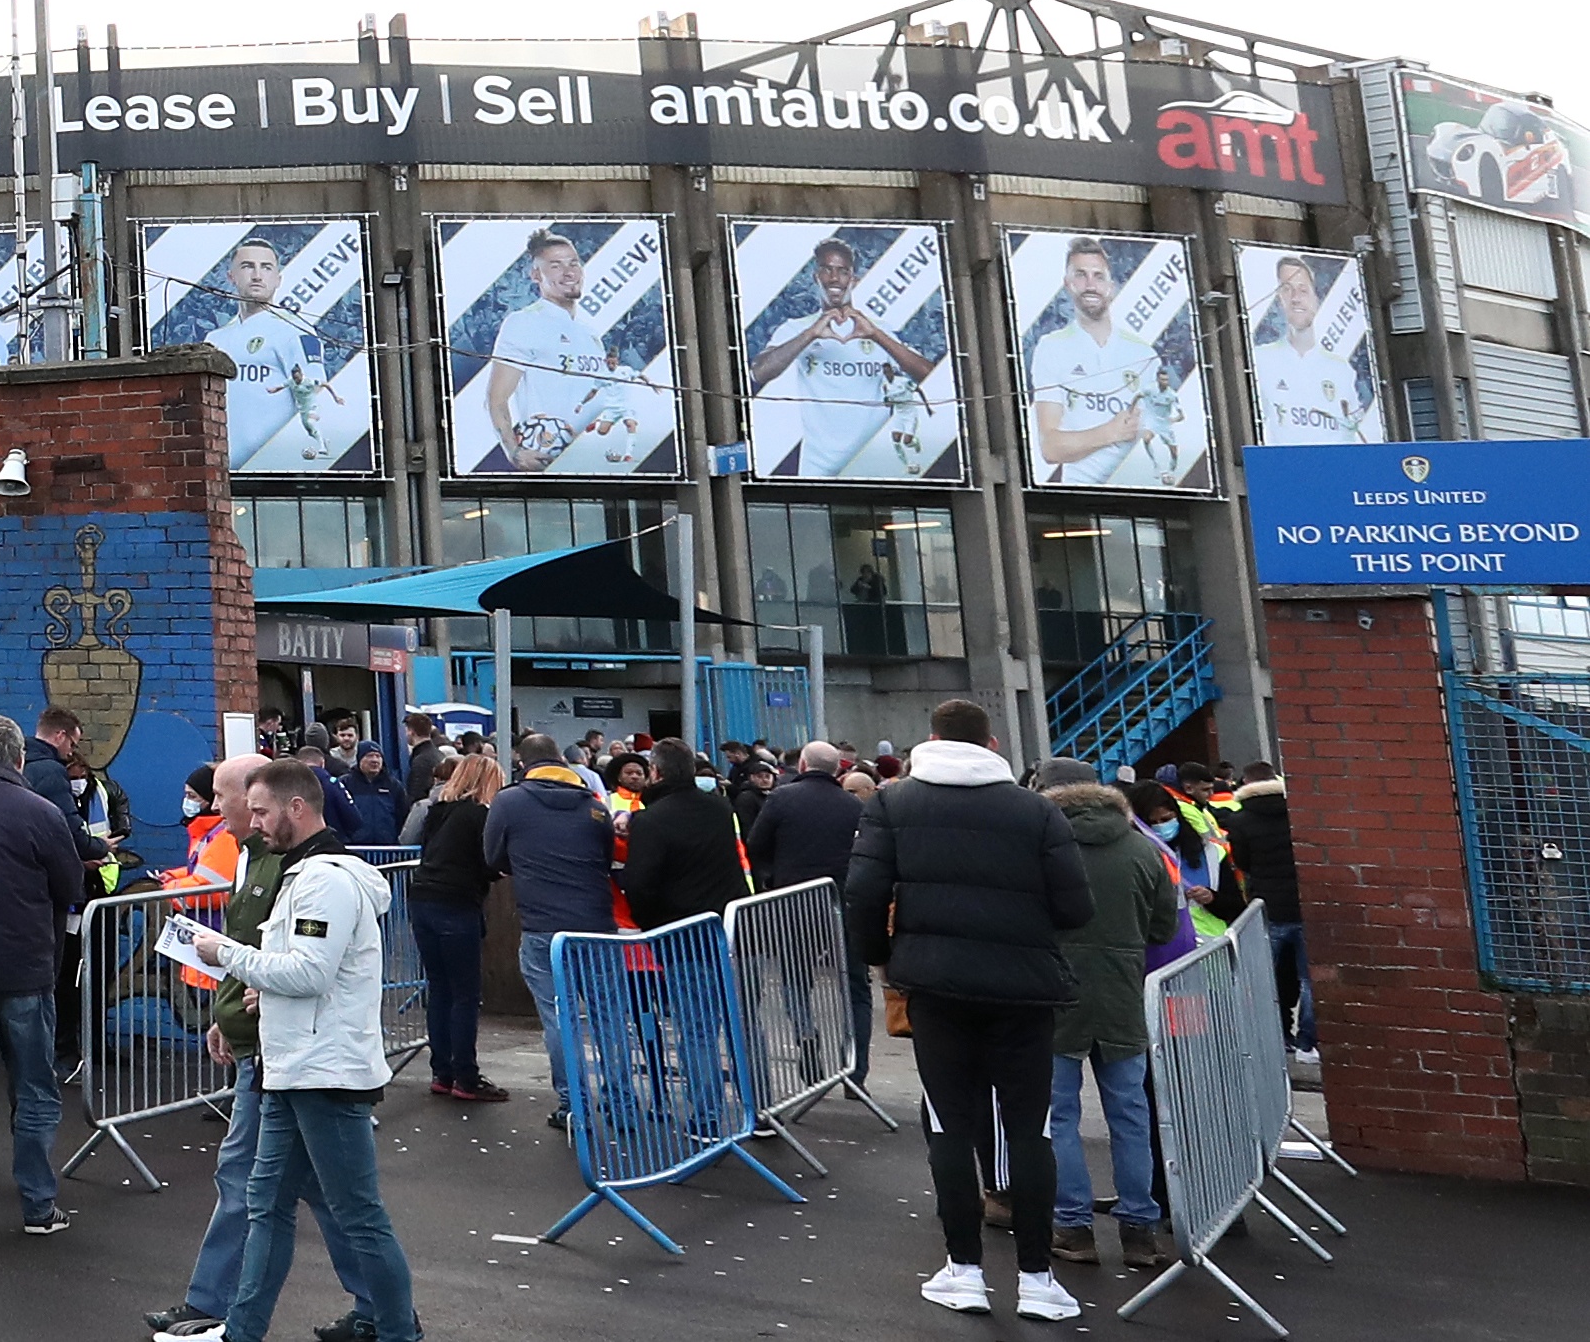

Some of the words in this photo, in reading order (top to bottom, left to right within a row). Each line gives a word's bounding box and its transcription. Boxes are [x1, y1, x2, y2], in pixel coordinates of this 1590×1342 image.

[54, 85, 237, 134] Lease
[292, 78, 420, 136] Buy
[474, 74, 593, 126] Sell
[651, 78, 1113, 144] amtauto.co.uk
[1156, 108, 1327, 186] amt
[278, 232, 361, 314] BELIEVE
[577, 232, 660, 318] BELIEVE
[865, 235, 939, 318] BELIEVE
[1124, 253, 1186, 334] BELIEVE
[1320, 286, 1364, 353] BELIEVE
[823, 360, 883, 378] SBOTOP
[1352, 489, 1409, 506] LEEDS
[1413, 488, 1486, 505] UNITED
[1277, 525, 1321, 544] NO
[1330, 523, 1451, 544] PARKING
[1459, 522, 1580, 543] BEYOND
[1350, 553, 1412, 573] THIS
[1421, 553, 1506, 573] POINT
[277, 622, 346, 660] BATTY
